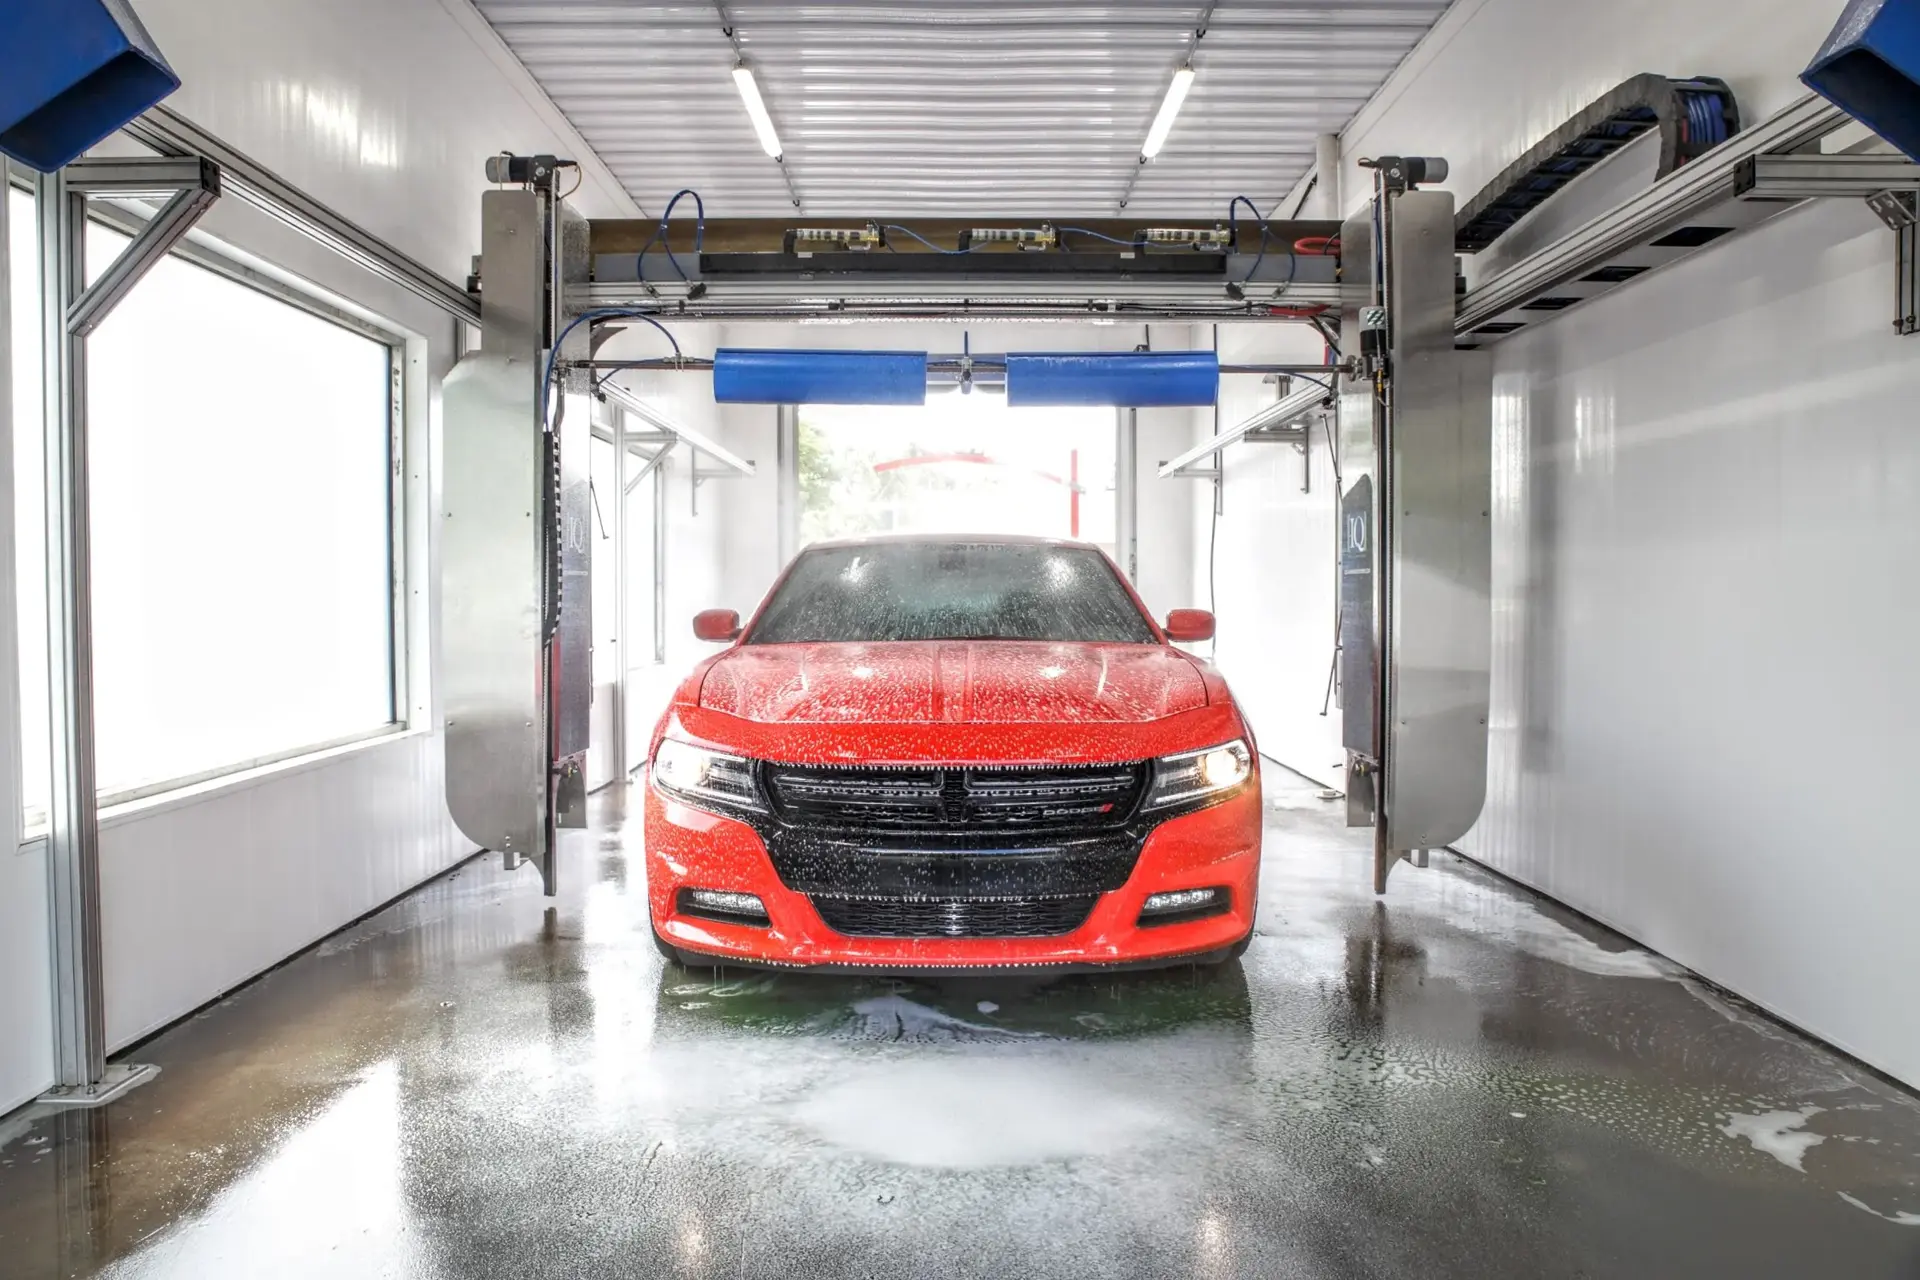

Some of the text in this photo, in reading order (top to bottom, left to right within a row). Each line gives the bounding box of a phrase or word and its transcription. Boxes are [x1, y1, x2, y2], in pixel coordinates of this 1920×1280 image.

[569, 516, 583, 554] IQ
[1350, 515, 1365, 552] IQ
[1043, 806, 1101, 816] DODGE
